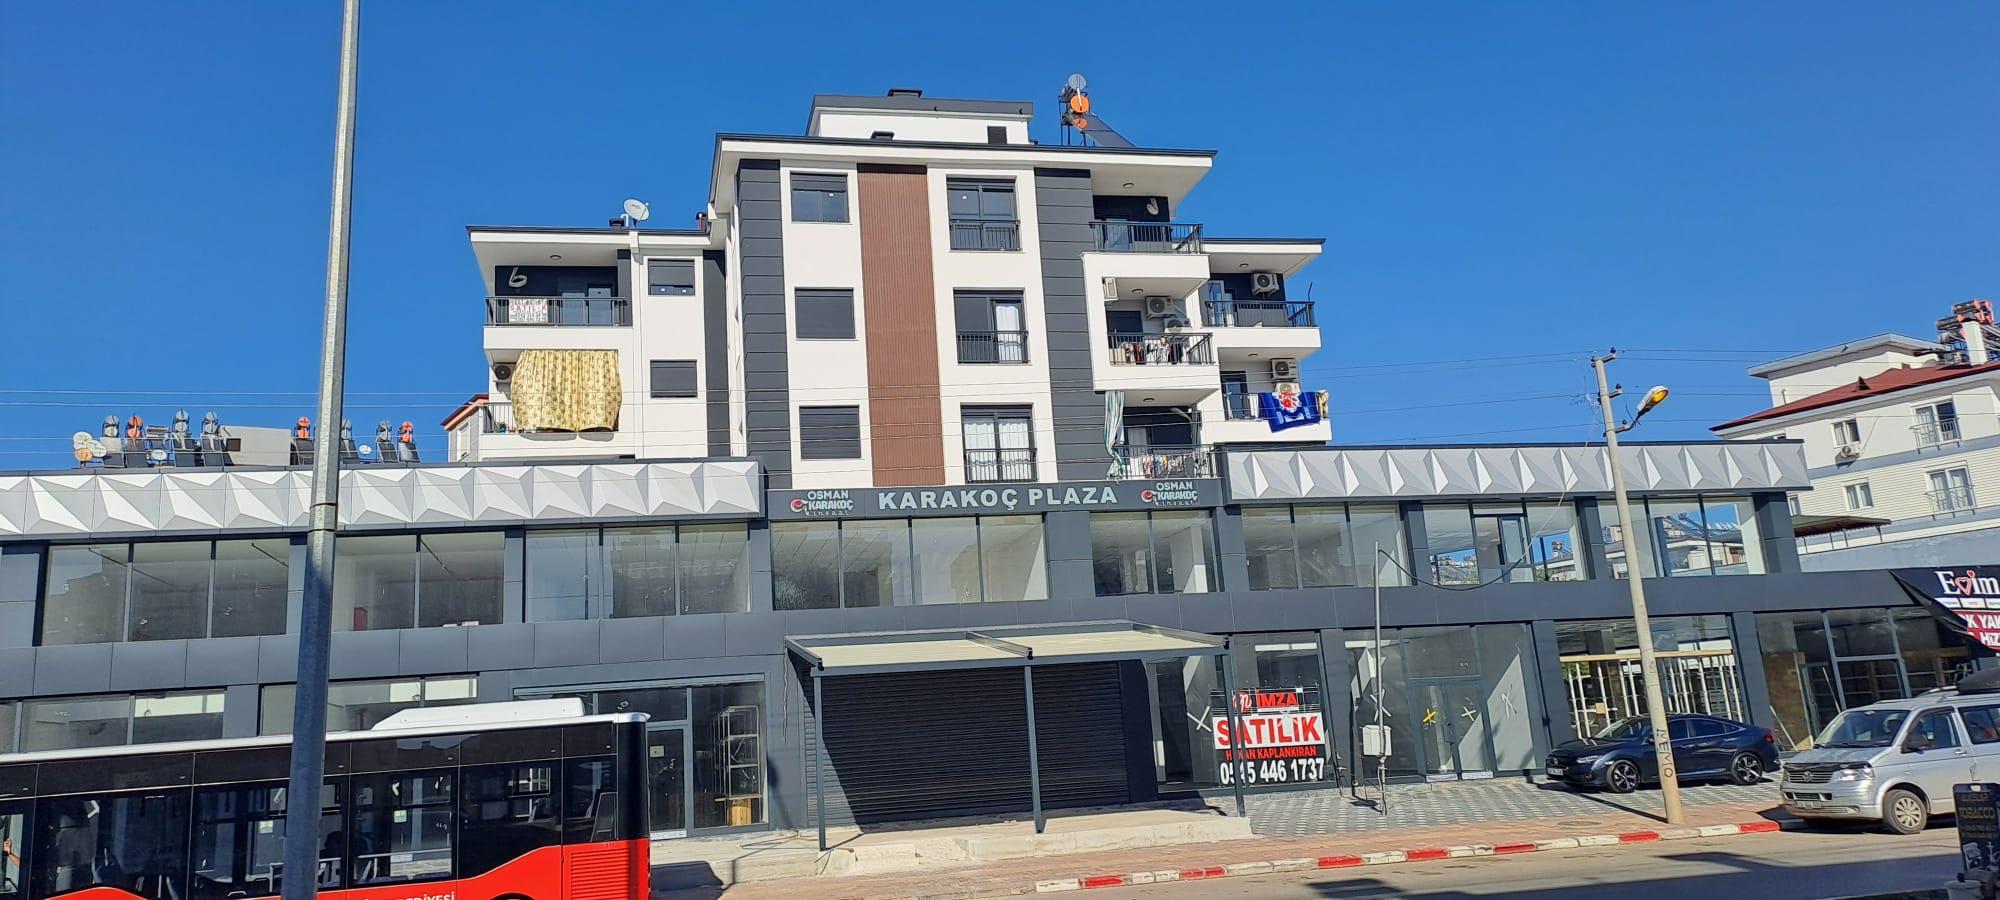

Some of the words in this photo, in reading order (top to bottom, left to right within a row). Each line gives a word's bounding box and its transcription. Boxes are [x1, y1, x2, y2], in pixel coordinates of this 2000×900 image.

[1156, 481, 1193, 491] OSMAN
[807, 490, 849, 500] OSMAN
[878, 489, 1018, 511] KARAKOÇ
[1028, 486, 1118, 505] PLAZA
[1157, 490, 1198, 501] KARAKOÇ
[808, 500, 854, 511] KARAKOÇ
[1256, 690, 1299, 708] İMZA
[1260, 759, 1287, 783] 446
[1291, 757, 1324, 781] 1737
